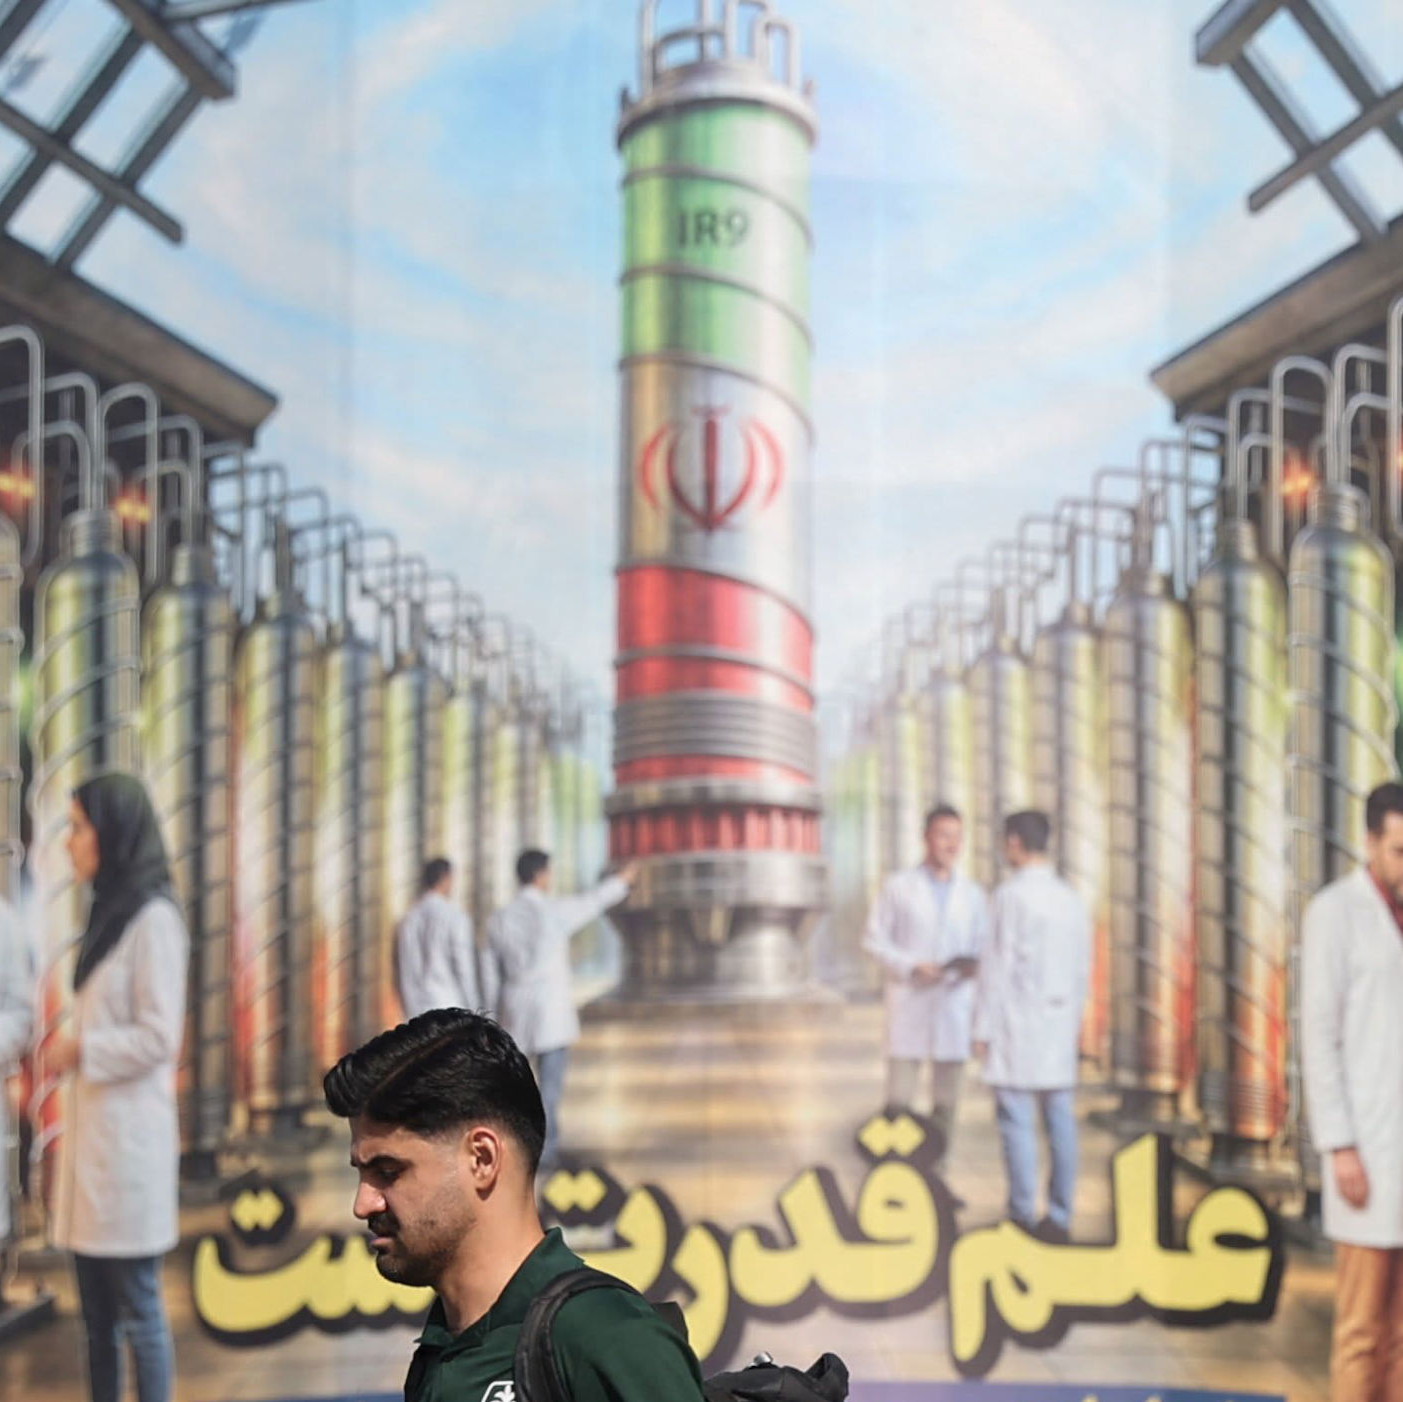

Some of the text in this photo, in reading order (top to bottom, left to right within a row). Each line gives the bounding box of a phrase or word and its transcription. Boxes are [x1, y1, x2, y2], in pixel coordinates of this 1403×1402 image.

[678, 211, 752, 248] IR9
[193, 1187, 436, 1333] ست
[950, 1134, 1272, 1364] علم
